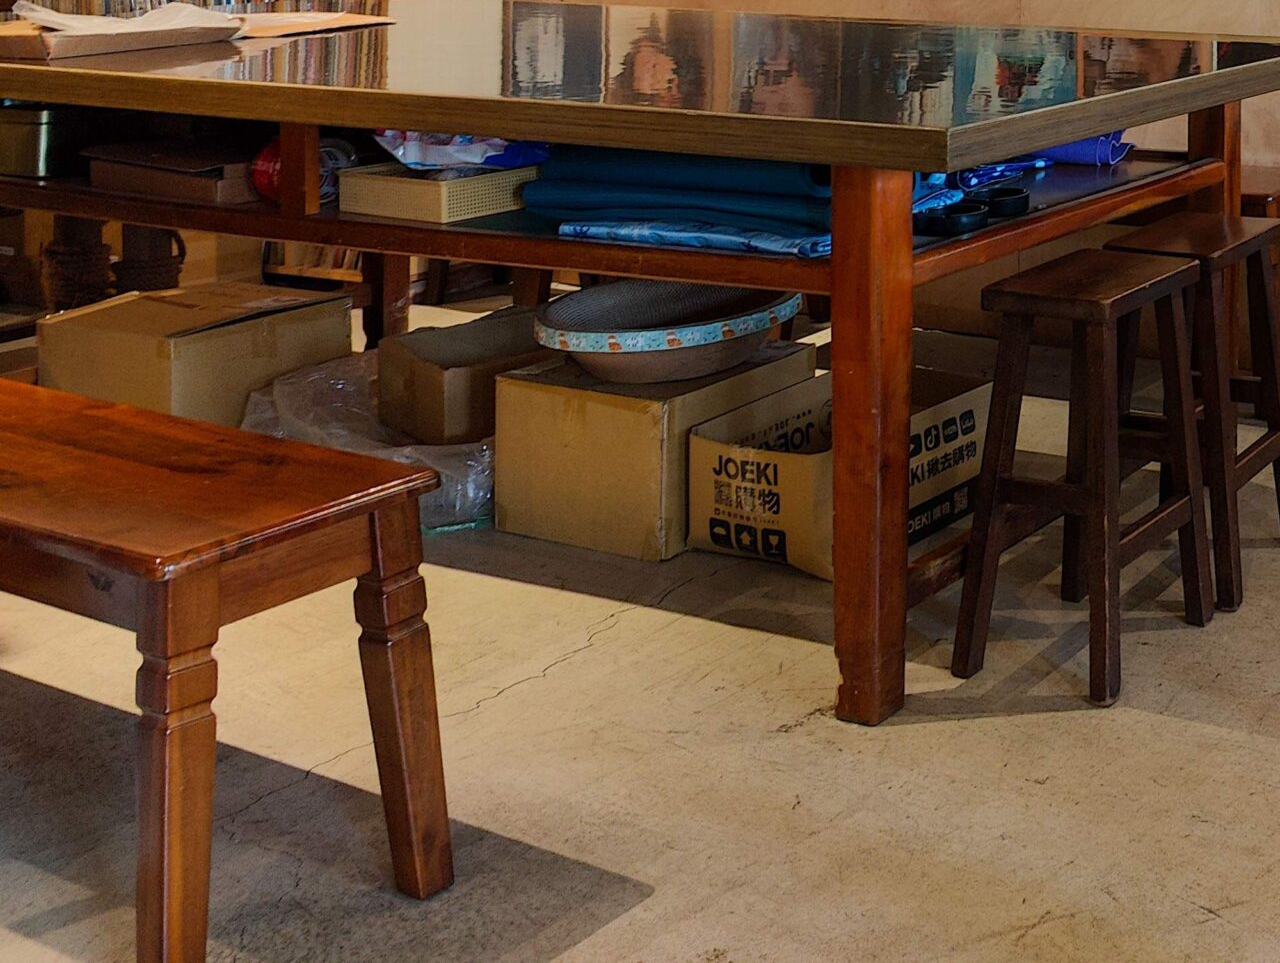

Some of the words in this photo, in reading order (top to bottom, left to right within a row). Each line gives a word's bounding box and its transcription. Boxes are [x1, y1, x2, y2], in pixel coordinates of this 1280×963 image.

[712, 455, 779, 487] JOEKI
[926, 440, 977, 479] 揪去購物
[908, 511, 932, 534] OEKI
